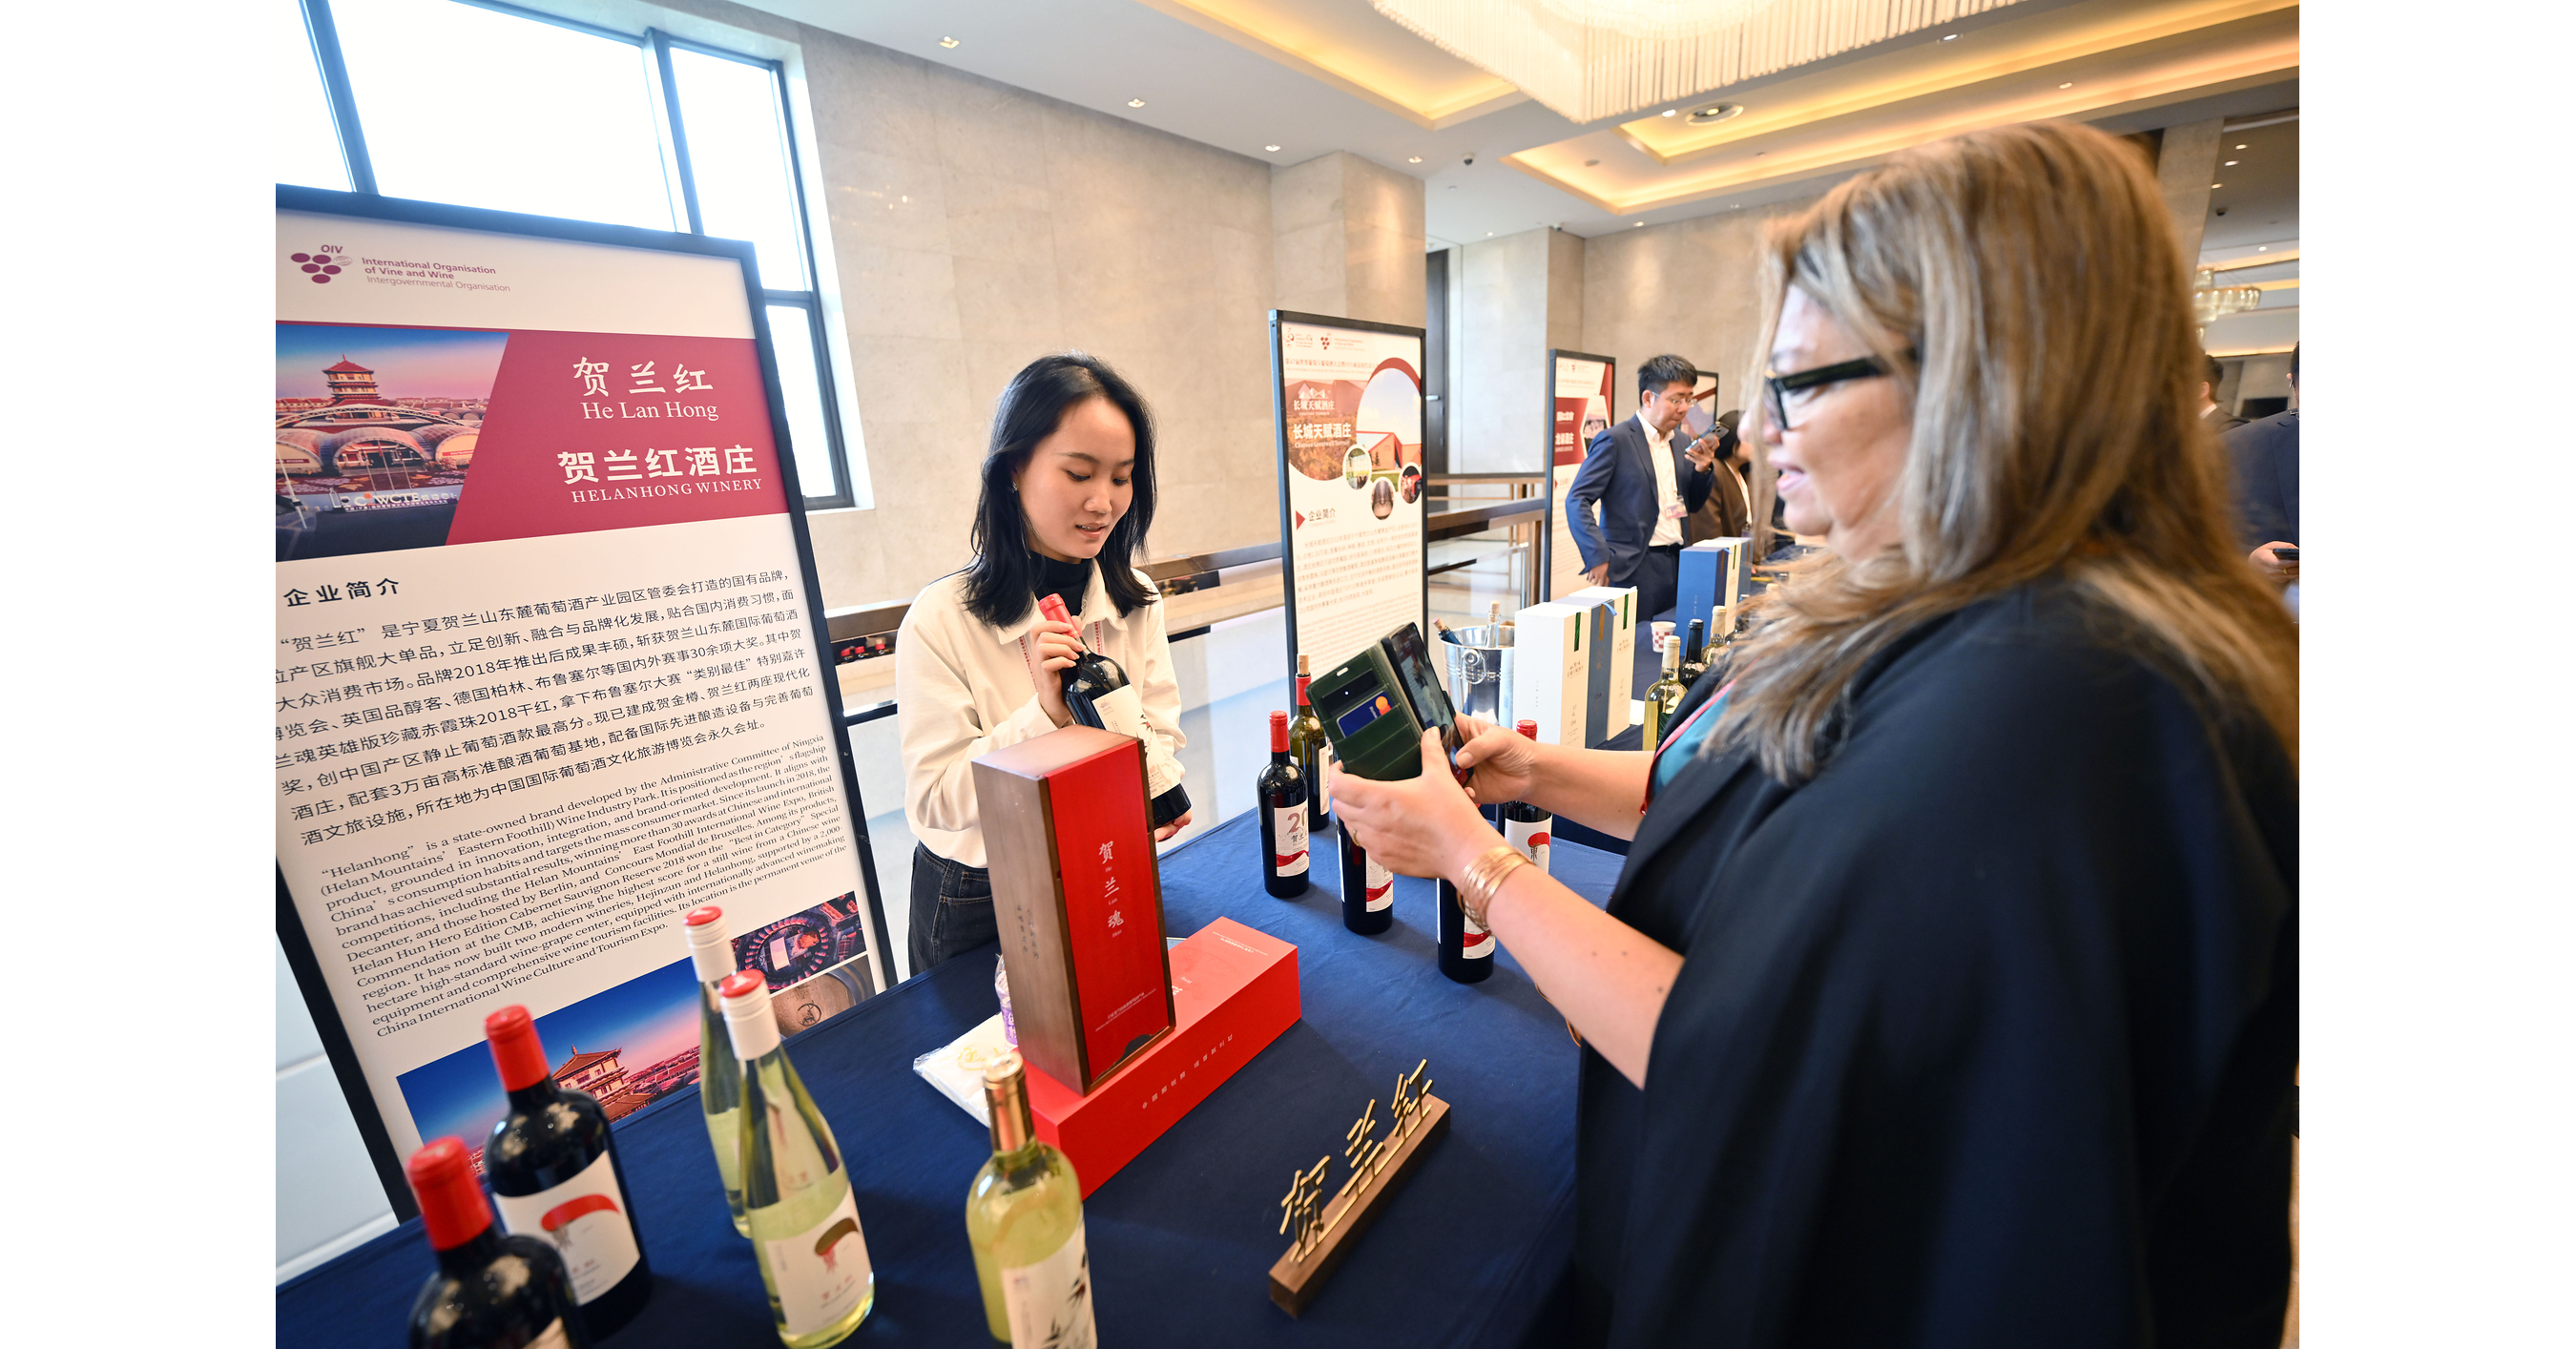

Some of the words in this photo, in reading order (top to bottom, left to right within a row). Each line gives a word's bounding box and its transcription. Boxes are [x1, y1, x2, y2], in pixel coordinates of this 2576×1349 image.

[321, 244, 343, 254] OIV
[362, 257, 430, 270] International
[433, 262, 496, 275] Organisation
[367, 276, 453, 288] Intergovernmental
[455, 280, 510, 292] Organisation
[379, 267, 404, 277] Vine
[405, 269, 426, 278] and
[429, 270, 454, 280] Wine
[572, 356, 714, 397] 贺兰红
[583, 401, 613, 420] He
[620, 400, 661, 419] Lan
[666, 400, 719, 422] Hong
[1293, 423, 1351, 440] 长城天赋酒庄
[556, 444, 758, 486] 贺兰红酒庄
[571, 482, 693, 504] HELANHONG
[696, 477, 762, 495] WINERY
[1308, 508, 1336, 522] 企业简介
[283, 576, 401, 608] 企业简介
[425, 841, 438, 851] is
[451, 814, 527, 843] state-owned
[529, 804, 565, 821] brand
[567, 788, 622, 811] developed
[624, 785, 637, 796] by
[639, 780, 656, 790] the
[659, 761, 729, 785] Administrative
[731, 747, 779, 765] Committee
[780, 741, 790, 751] of
[792, 735, 823, 748] Ningxia
[321, 876, 369, 897] (Helan
[456, 837, 505, 856] Eastern
[505, 820, 554, 841] Foothill)
[554, 813, 586, 826] Wine
[586, 799, 632, 819] Industry
[633, 792, 659, 805] Park.
[677, 771, 727, 794] positioned
[737, 766, 753, 775] the
[794, 745, 825, 758] flagship
[325, 885, 386, 912] product,
[390, 862, 455, 892] grounded
[457, 860, 472, 869] in
[474, 840, 544, 864] innovation,
[546, 820, 611, 843] integration,
[613, 810, 634, 823] and
[635, 788, 710, 817] brand-oriented
[712, 772, 772, 794] development.
[783, 761, 808, 773] aligns
[809, 755, 828, 765] with
[335, 914, 380, 936] brand
[379, 908, 405, 922] has
[405, 887, 464, 914] achieved
[465, 866, 530, 895] substantial
[531, 857, 572, 874] results,
[573, 841, 619, 860] winning
[619, 833, 647, 846] more
[647, 825, 671, 838] than
[671, 820, 682, 830] 30
[683, 810, 717, 826] awards
[717, 807, 726, 816] at
[727, 798, 762, 812] Chinese
[763, 790, 779, 801] and
[779, 774, 832, 797] international
[341, 914, 435, 948] competitions,
[438, 892, 499, 917] including
[500, 885, 521, 897] the
[523, 873, 559, 889] Helan
[632, 841, 654, 855] East
[656, 828, 694, 847] Foothill
[696, 809, 756, 834] International
[758, 802, 780, 814] Wine
[782, 796, 806, 806] Expo,
[807, 784, 834, 799] British
[345, 935, 413, 962] Decanter,
[415, 923, 441, 939] and
[442, 913, 477, 929] those
[478, 897, 520, 918] hosted
[521, 893, 536, 903] by
[538, 882, 577, 898] Berlin,
[578, 870, 600, 884] and
[604, 855, 654, 876] Concours
[654, 840, 696, 860] Mondial
[696, 837, 709, 845] de
[710, 823, 754, 841] Bruxelles.
[756, 812, 787, 826] Among
[799, 797, 836, 814] products,
[350, 956, 394, 975] Helan
[395, 944, 426, 960] Hun
[426, 933, 461, 948] Hero
[462, 917, 508, 937] Edition
[509, 897, 563, 920] Cabernet
[563, 879, 620, 903] Sauvignon
[621, 864, 661, 882] Reserve
[662, 855, 685, 869] 2018
[686, 849, 707, 861] won
[708, 843, 723, 854] the
[754, 830, 763, 839] in
[810, 803, 839, 820] Special
[1104, 876, 1120, 898] 兰
[365, 989, 418, 1013] hectare
[419, 954, 508, 993] high-standard
[509, 932, 572, 960] wine-grape
[574, 919, 613, 936] center,
[614, 898, 661, 922] equipped
[663, 891, 685, 903] with
[687, 867, 753, 896] internationally
[755, 851, 795, 871] advanced
[796, 835, 845, 856] winemaking
[376, 1018, 418, 1037] China
[417, 983, 500, 1022] International
[500, 973, 532, 988] Wine
[532, 957, 574, 977] Culture
[575, 946, 596, 961] and
[595, 932, 639, 953] Tourism
[639, 923, 668, 937] Expo.
